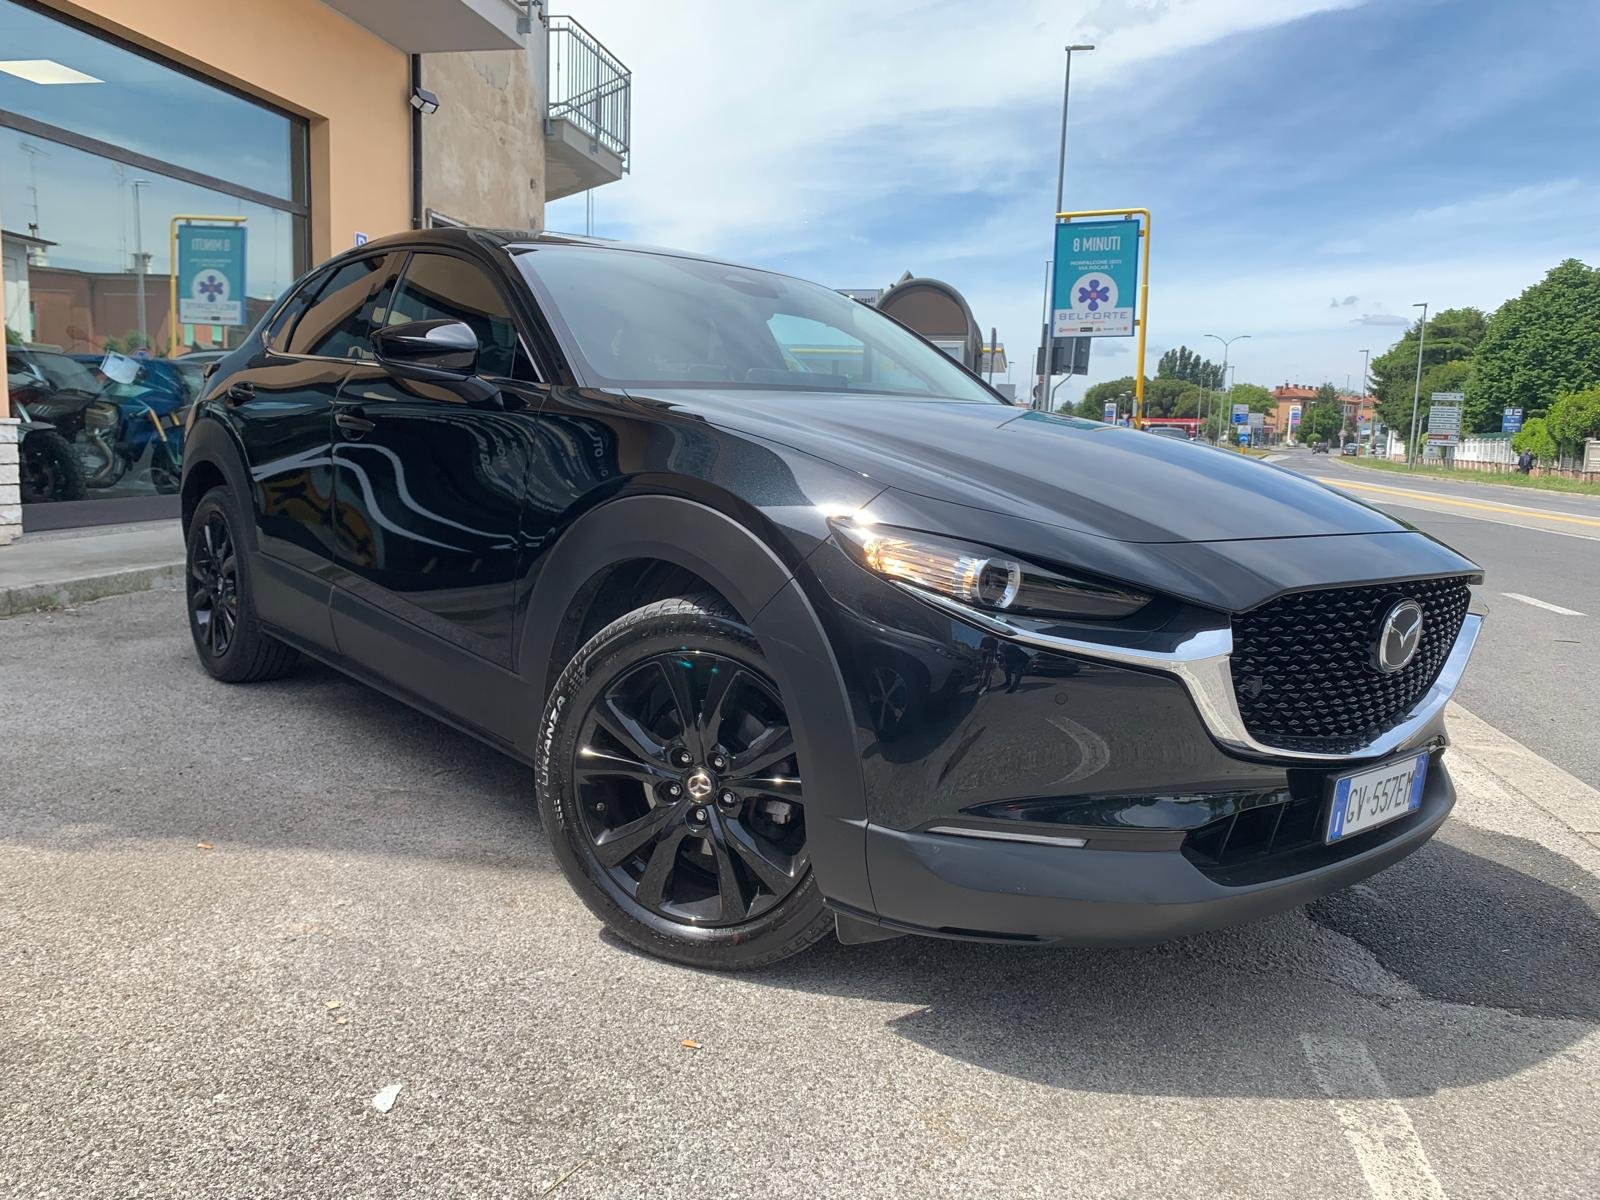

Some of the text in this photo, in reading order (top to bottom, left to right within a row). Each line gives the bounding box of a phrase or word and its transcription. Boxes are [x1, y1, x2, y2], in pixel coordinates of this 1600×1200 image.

[1073, 236, 1121, 252] 8 MINUTI
[1059, 311, 1128, 321] BELFORTE
